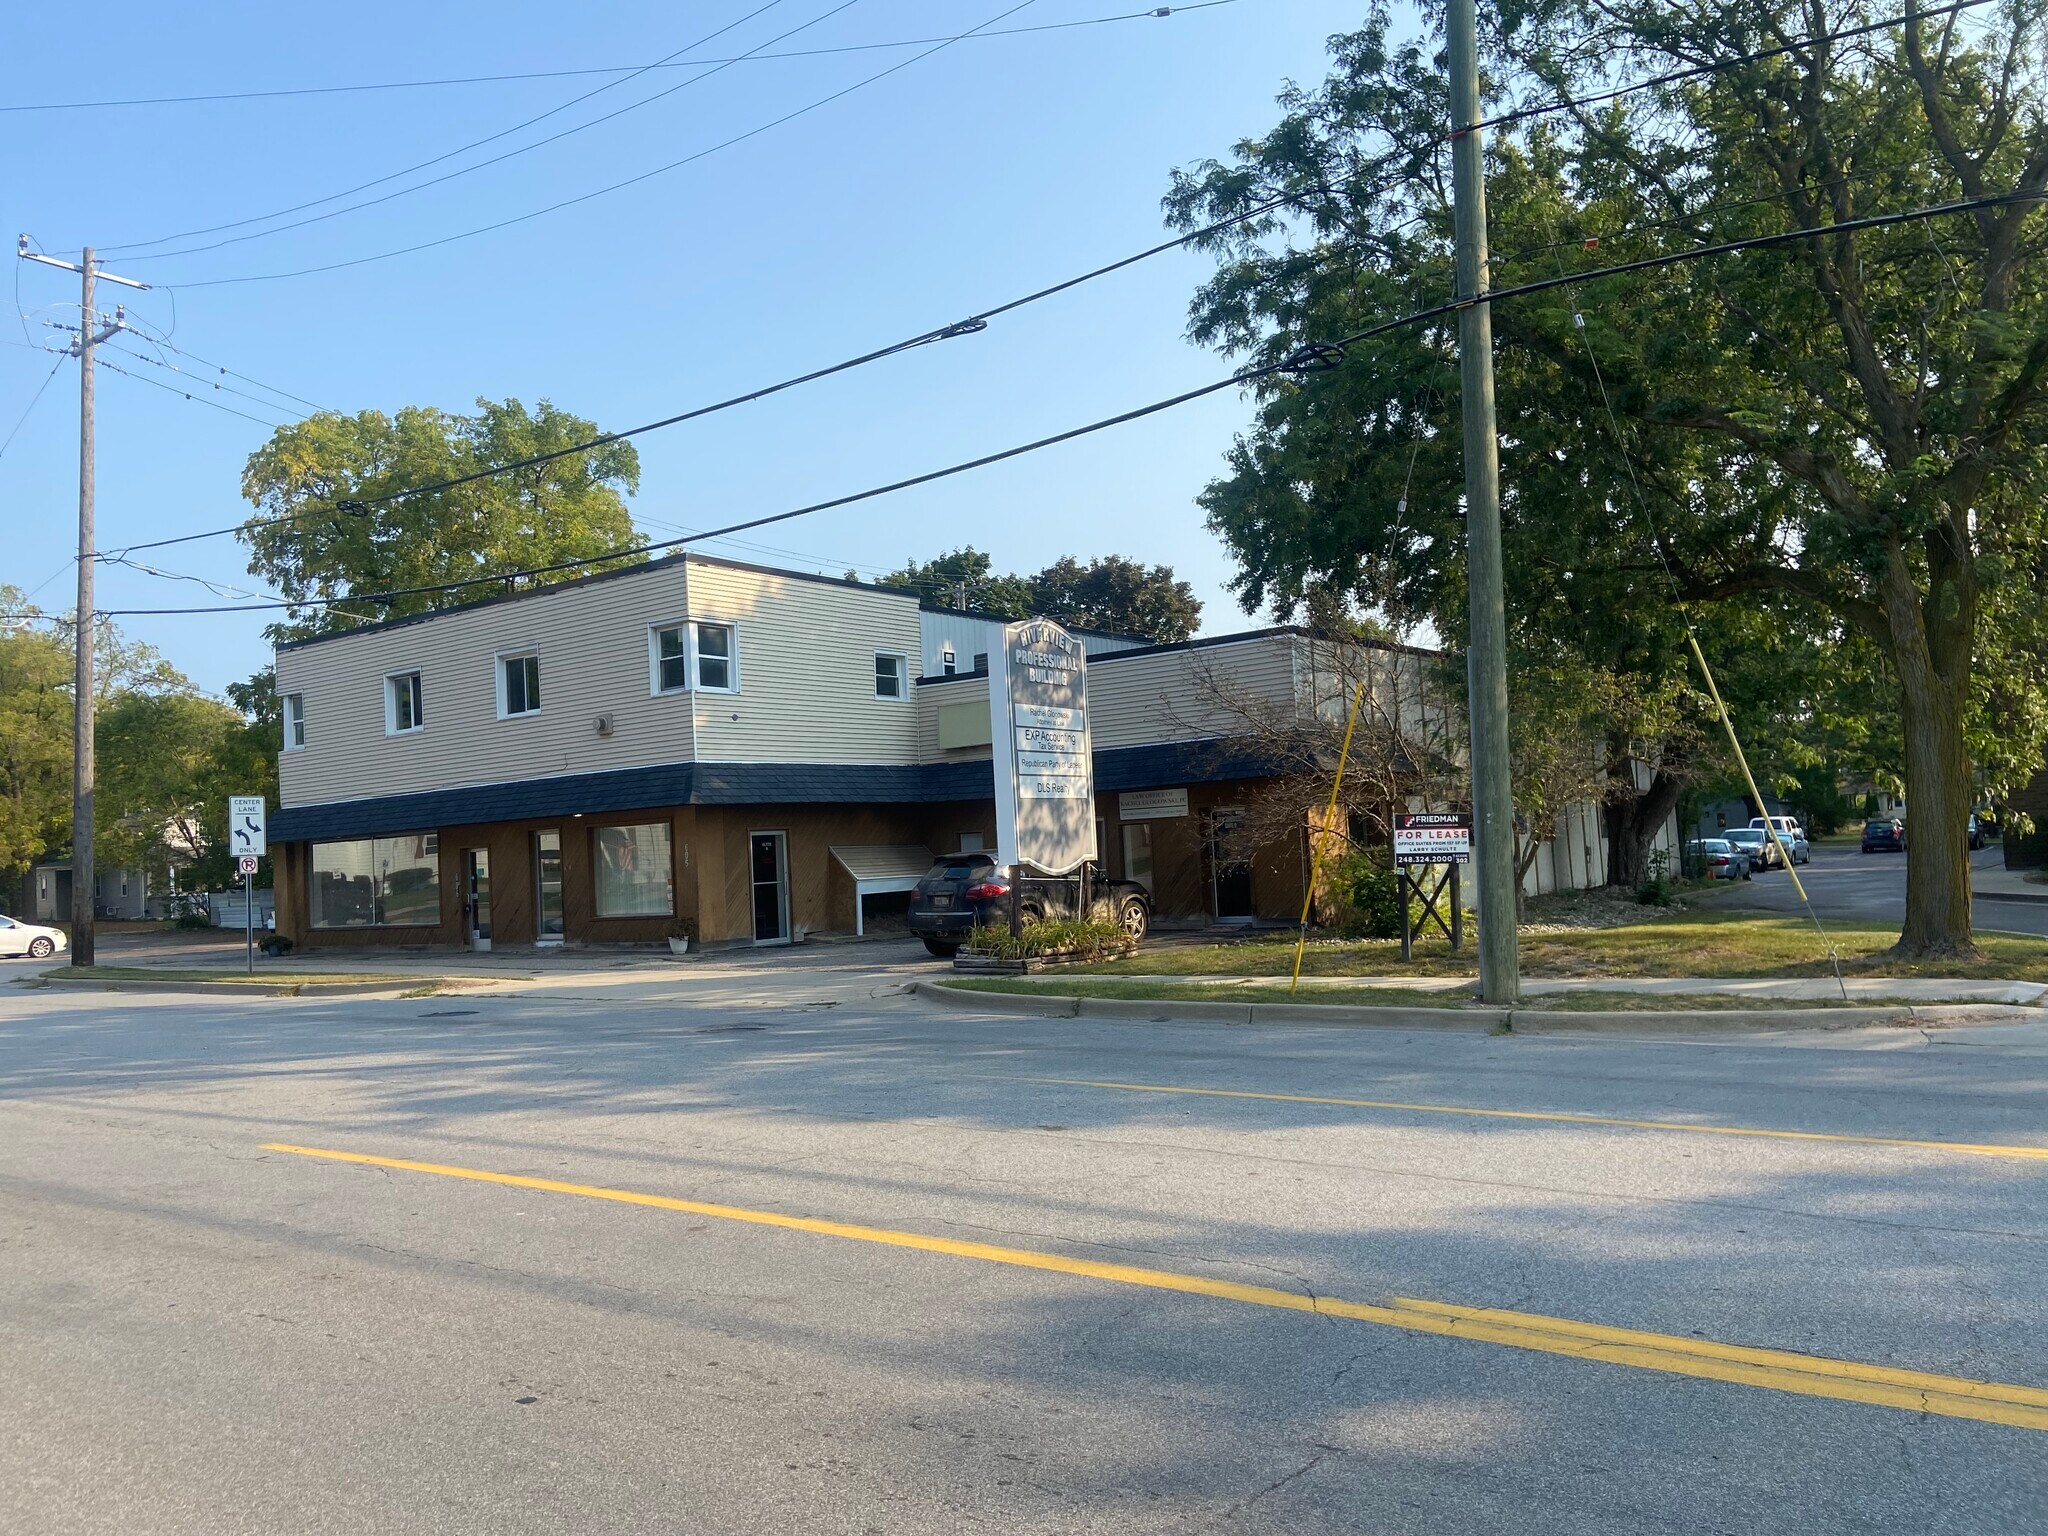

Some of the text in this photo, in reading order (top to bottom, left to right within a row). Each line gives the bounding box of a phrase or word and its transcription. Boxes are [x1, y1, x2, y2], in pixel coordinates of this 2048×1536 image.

[1019, 627, 1074, 654] RIVERVIEW
[1015, 649, 1077, 671] PROFESSIONAL
[1029, 667, 1067, 686] BUILDING
[1030, 708, 1046, 718] Rachel
[1025, 730, 1076, 746] EXP Accounting
[1038, 742, 1065, 751] Tax Service
[1022, 759, 1047, 768] Republican
[1049, 760, 1061, 768] Party
[1037, 783, 1050, 793] DLS
[1415, 815, 1459, 823] FRIEDMAN
[1397, 830, 1467, 839] FOR LEASE
[1398, 855, 1452, 863] 248.324.2000
